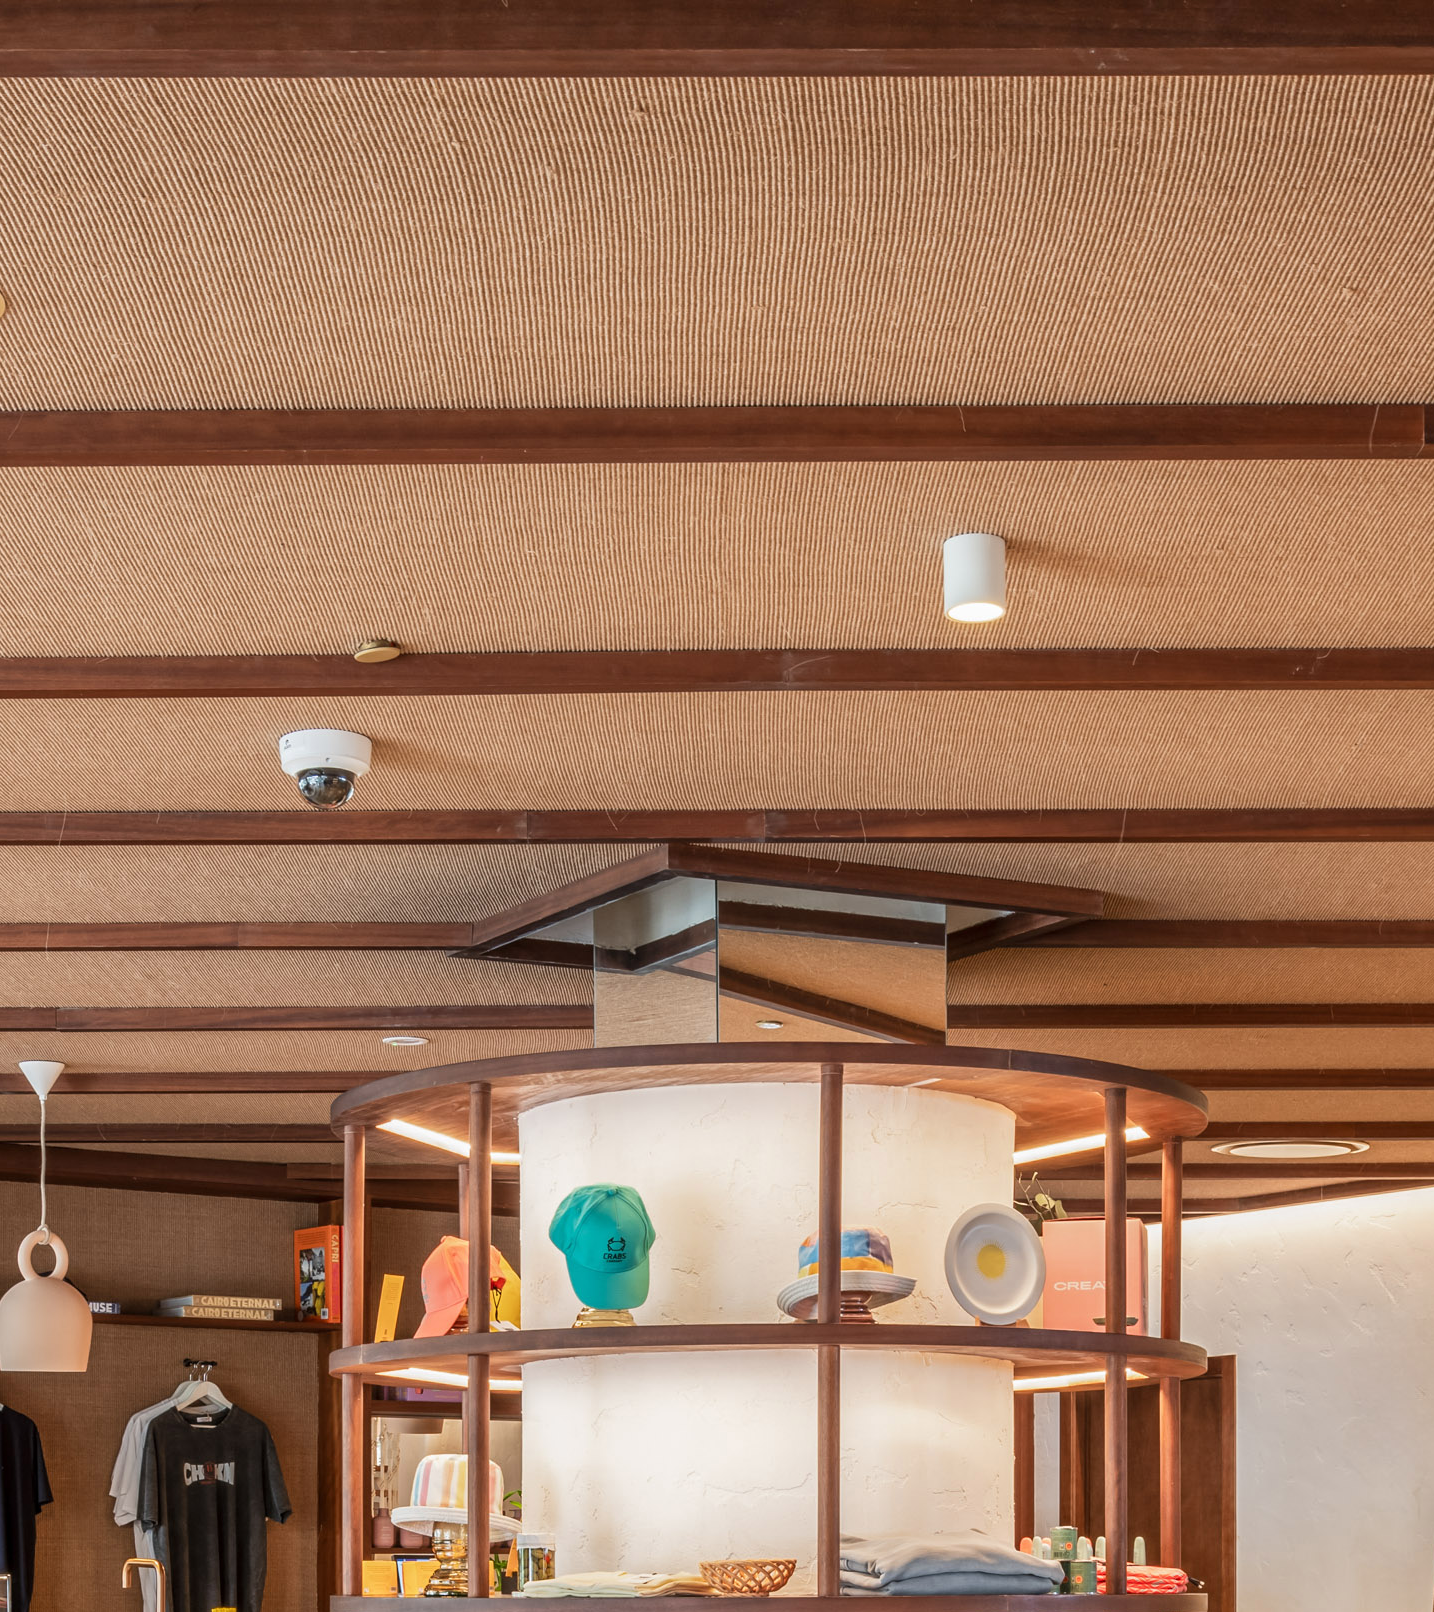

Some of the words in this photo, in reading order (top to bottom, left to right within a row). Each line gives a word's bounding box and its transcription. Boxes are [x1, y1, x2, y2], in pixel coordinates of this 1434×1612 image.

[331, 1234, 339, 1263] CAPRI
[603, 1252, 627, 1260] CRABS
[1054, 1281, 1106, 1291] CREA
[201, 1296, 229, 1307] CAIRO
[230, 1297, 275, 1309] ETERNAL
[192, 1308, 220, 1318] CAIRO
[222, 1308, 267, 1319] ETERNAL
